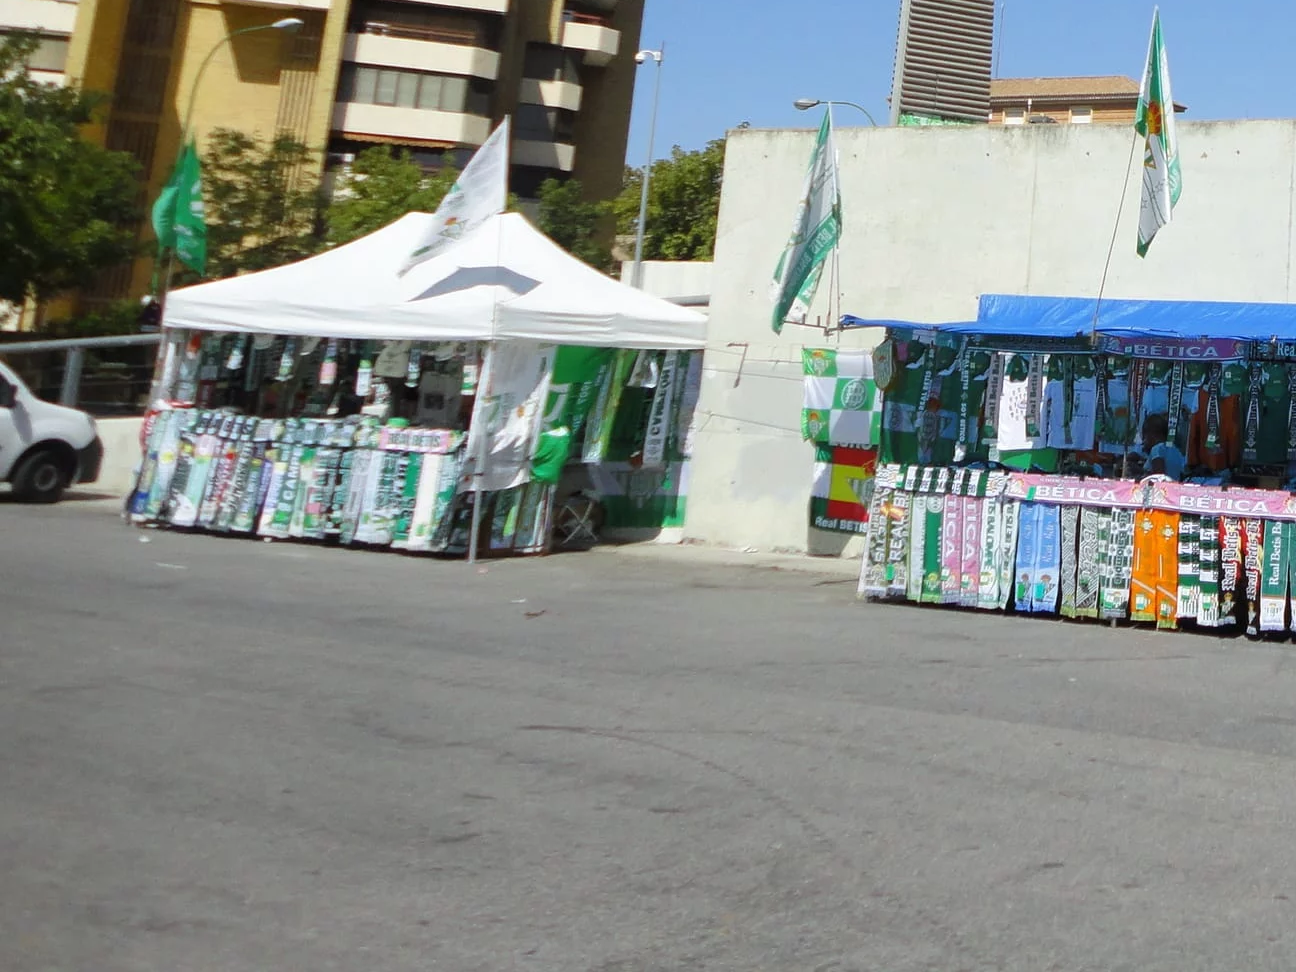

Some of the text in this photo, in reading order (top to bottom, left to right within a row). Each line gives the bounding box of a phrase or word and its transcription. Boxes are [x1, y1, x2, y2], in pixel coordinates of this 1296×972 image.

[1133, 343, 1219, 357] BÉTICA
[1036, 484, 1116, 501] BÉTICA
[1180, 495, 1268, 512] BÉTICA
[815, 516, 837, 529] Real
[1271, 535, 1282, 561] Betis
[1269, 561, 1280, 586] Real
